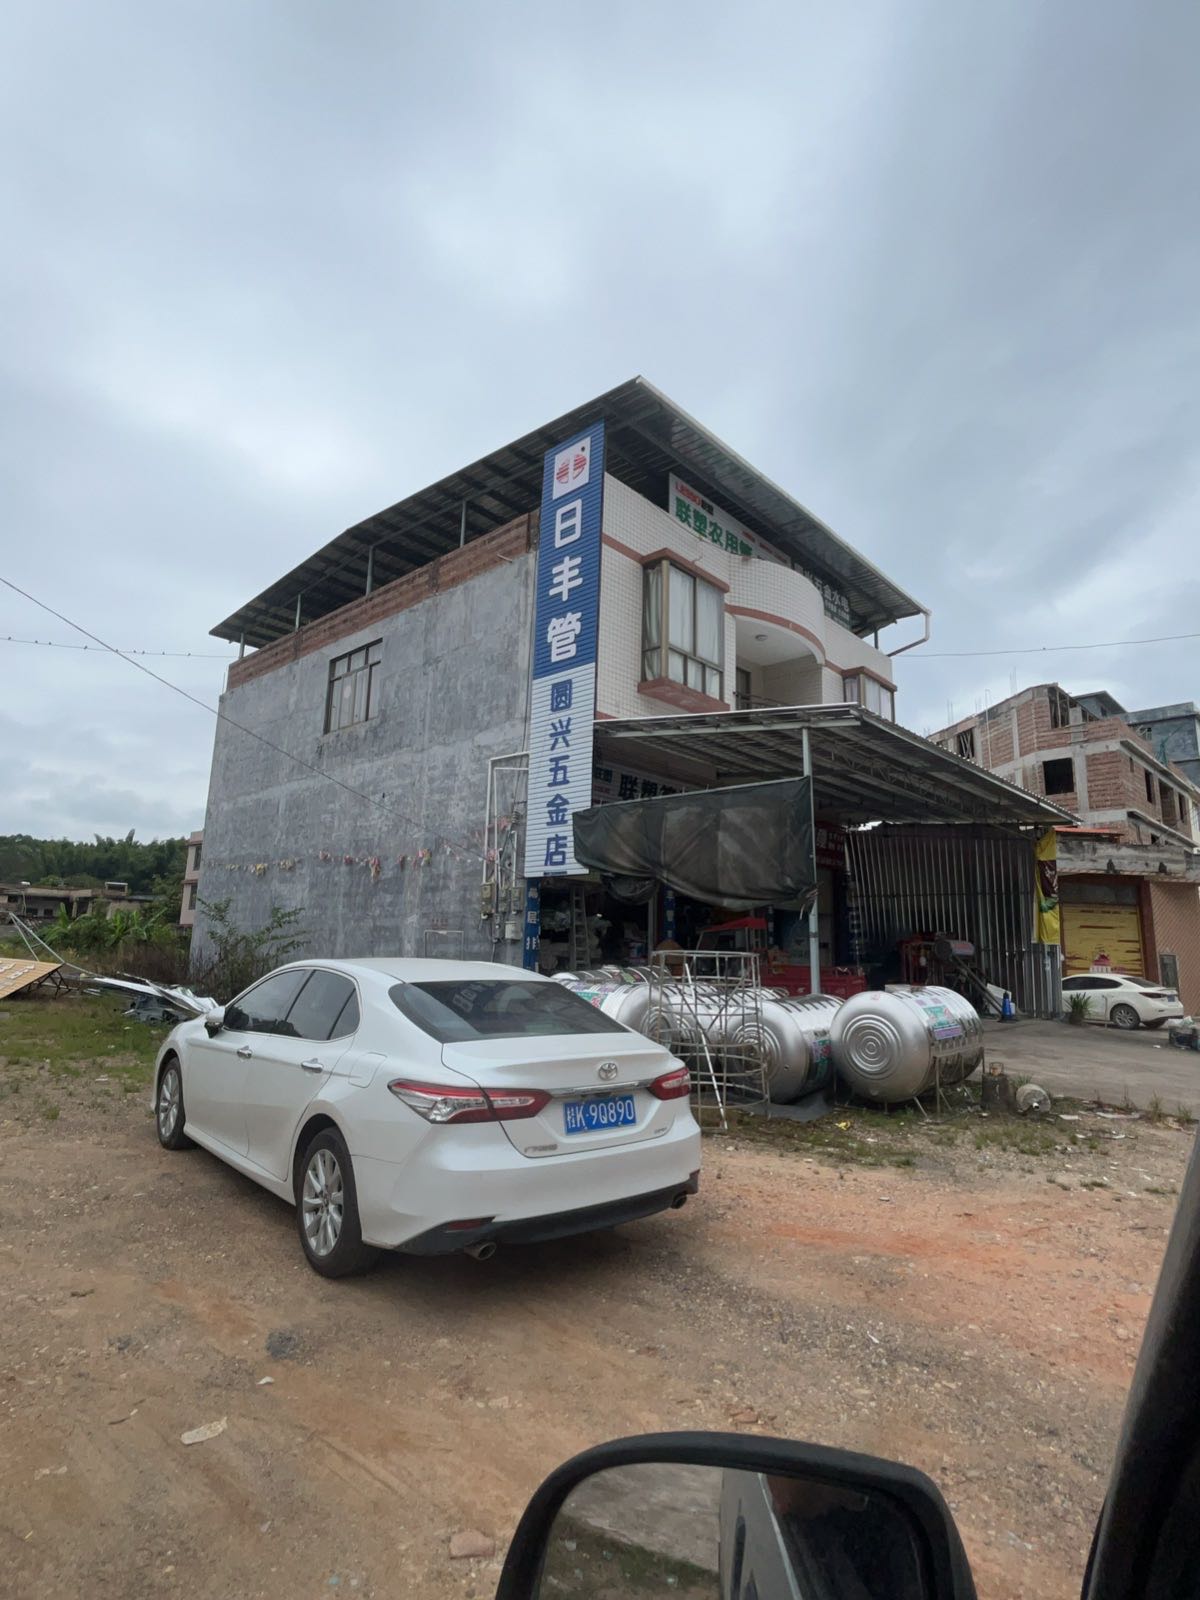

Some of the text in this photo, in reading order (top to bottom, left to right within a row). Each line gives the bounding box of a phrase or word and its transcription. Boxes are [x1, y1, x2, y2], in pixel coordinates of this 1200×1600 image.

[546, 497, 583, 663] 日丰管
[544, 678, 573, 867] 圆兴五金店
